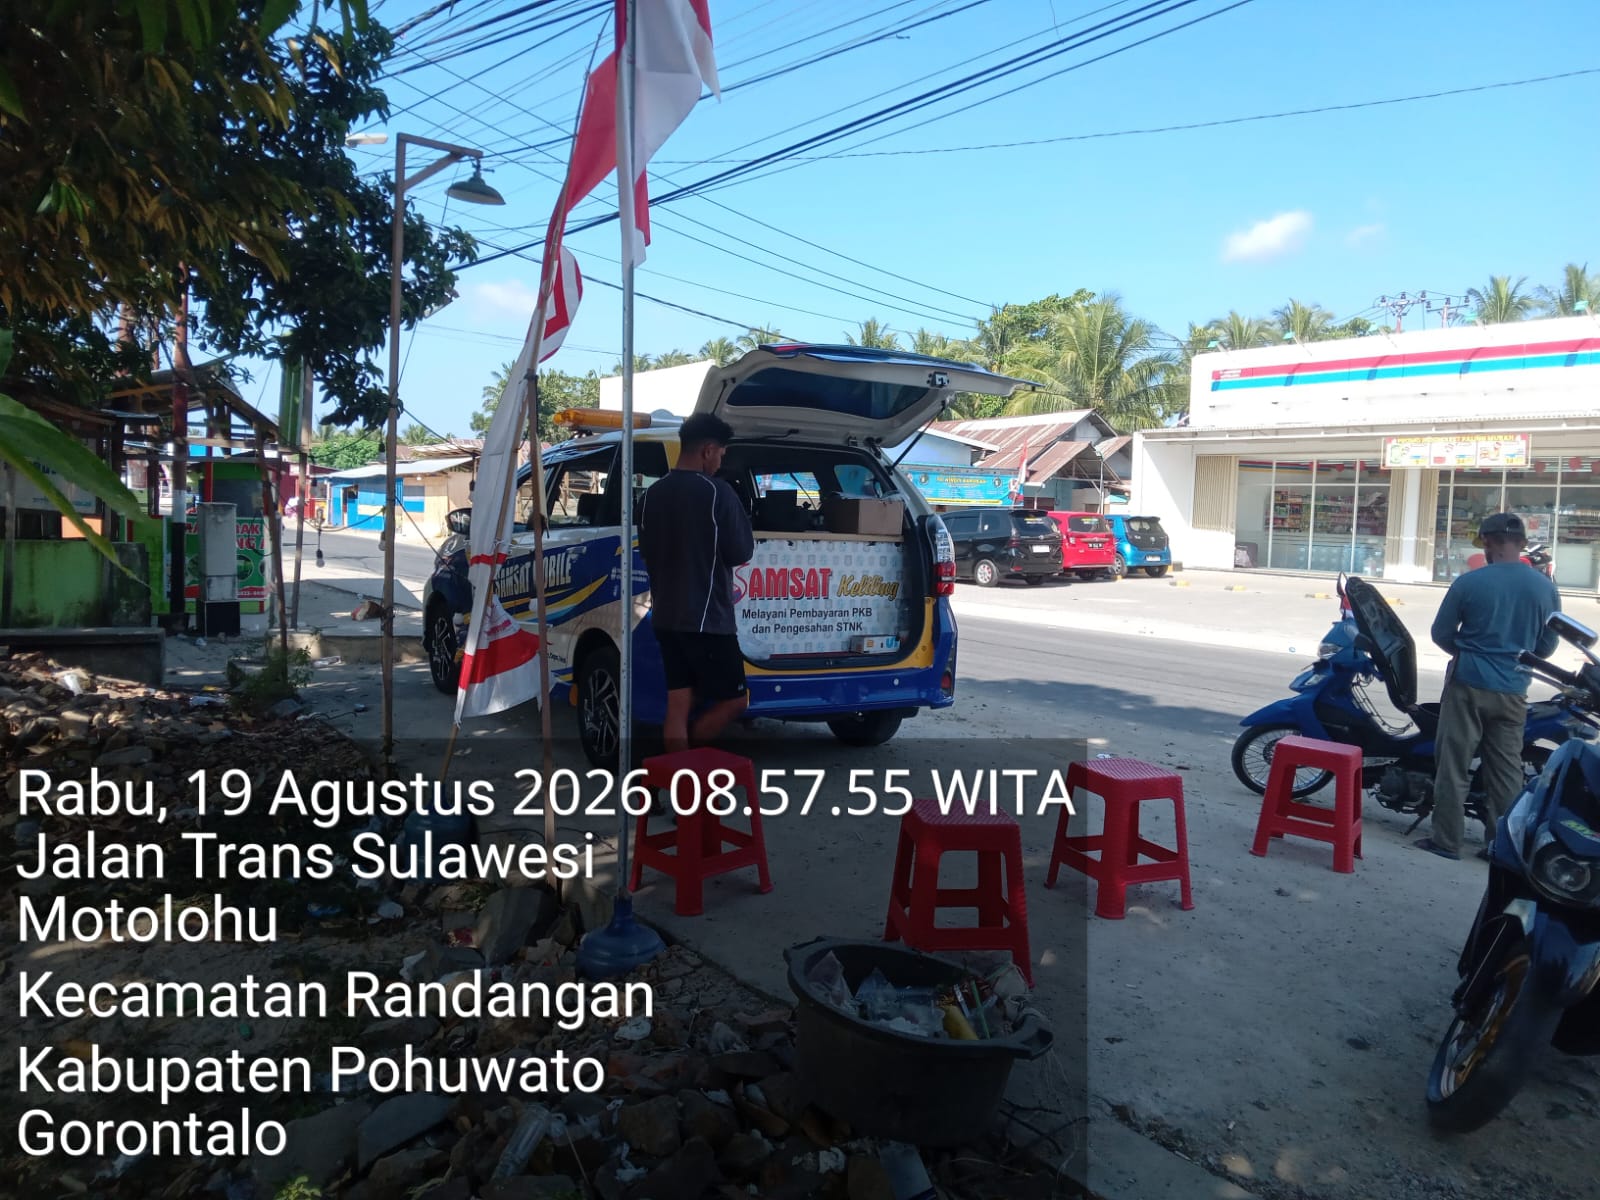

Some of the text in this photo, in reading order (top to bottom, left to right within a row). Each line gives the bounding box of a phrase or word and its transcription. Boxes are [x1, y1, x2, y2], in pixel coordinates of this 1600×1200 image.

[494, 561, 531, 598] SAMSAT
[533, 552, 572, 589] OBILE
[837, 574, 900, 601] Keliling
[742, 607, 873, 621] Melayani Pembayaran PKB
[751, 622, 864, 635] dan Pengesahan STNK
